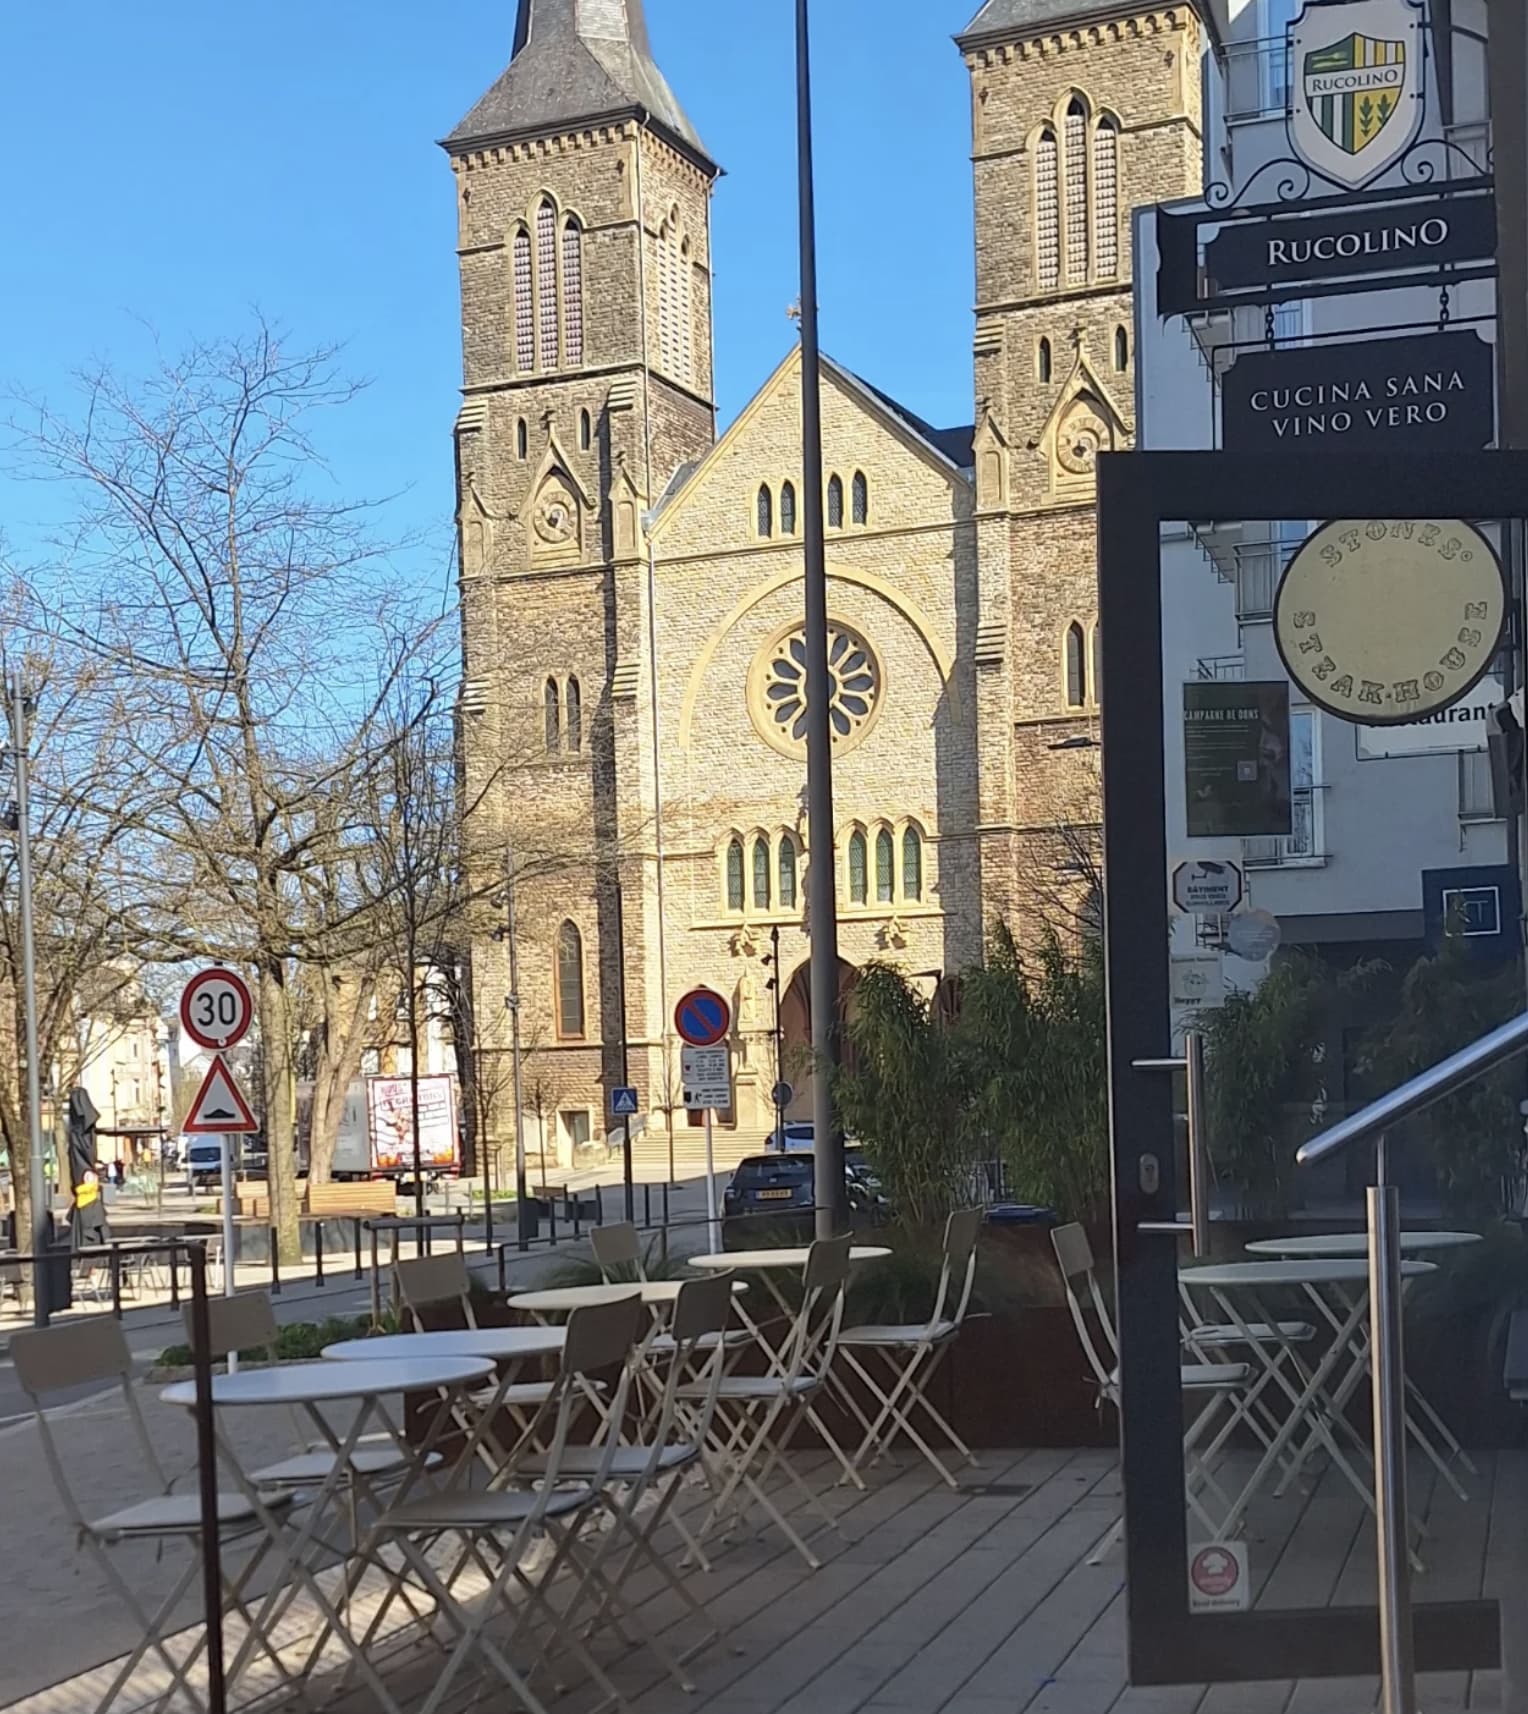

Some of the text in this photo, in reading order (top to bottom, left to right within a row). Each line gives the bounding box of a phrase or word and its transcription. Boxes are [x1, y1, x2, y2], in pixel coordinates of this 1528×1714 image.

[1312, 68, 1398, 92] RUCOLINO
[1267, 218, 1448, 265] RUCOLINO
[1250, 370, 1464, 411] CUCINA SANA
[1272, 402, 1447, 437] VINO VERO
[197, 991, 236, 1027] 30
